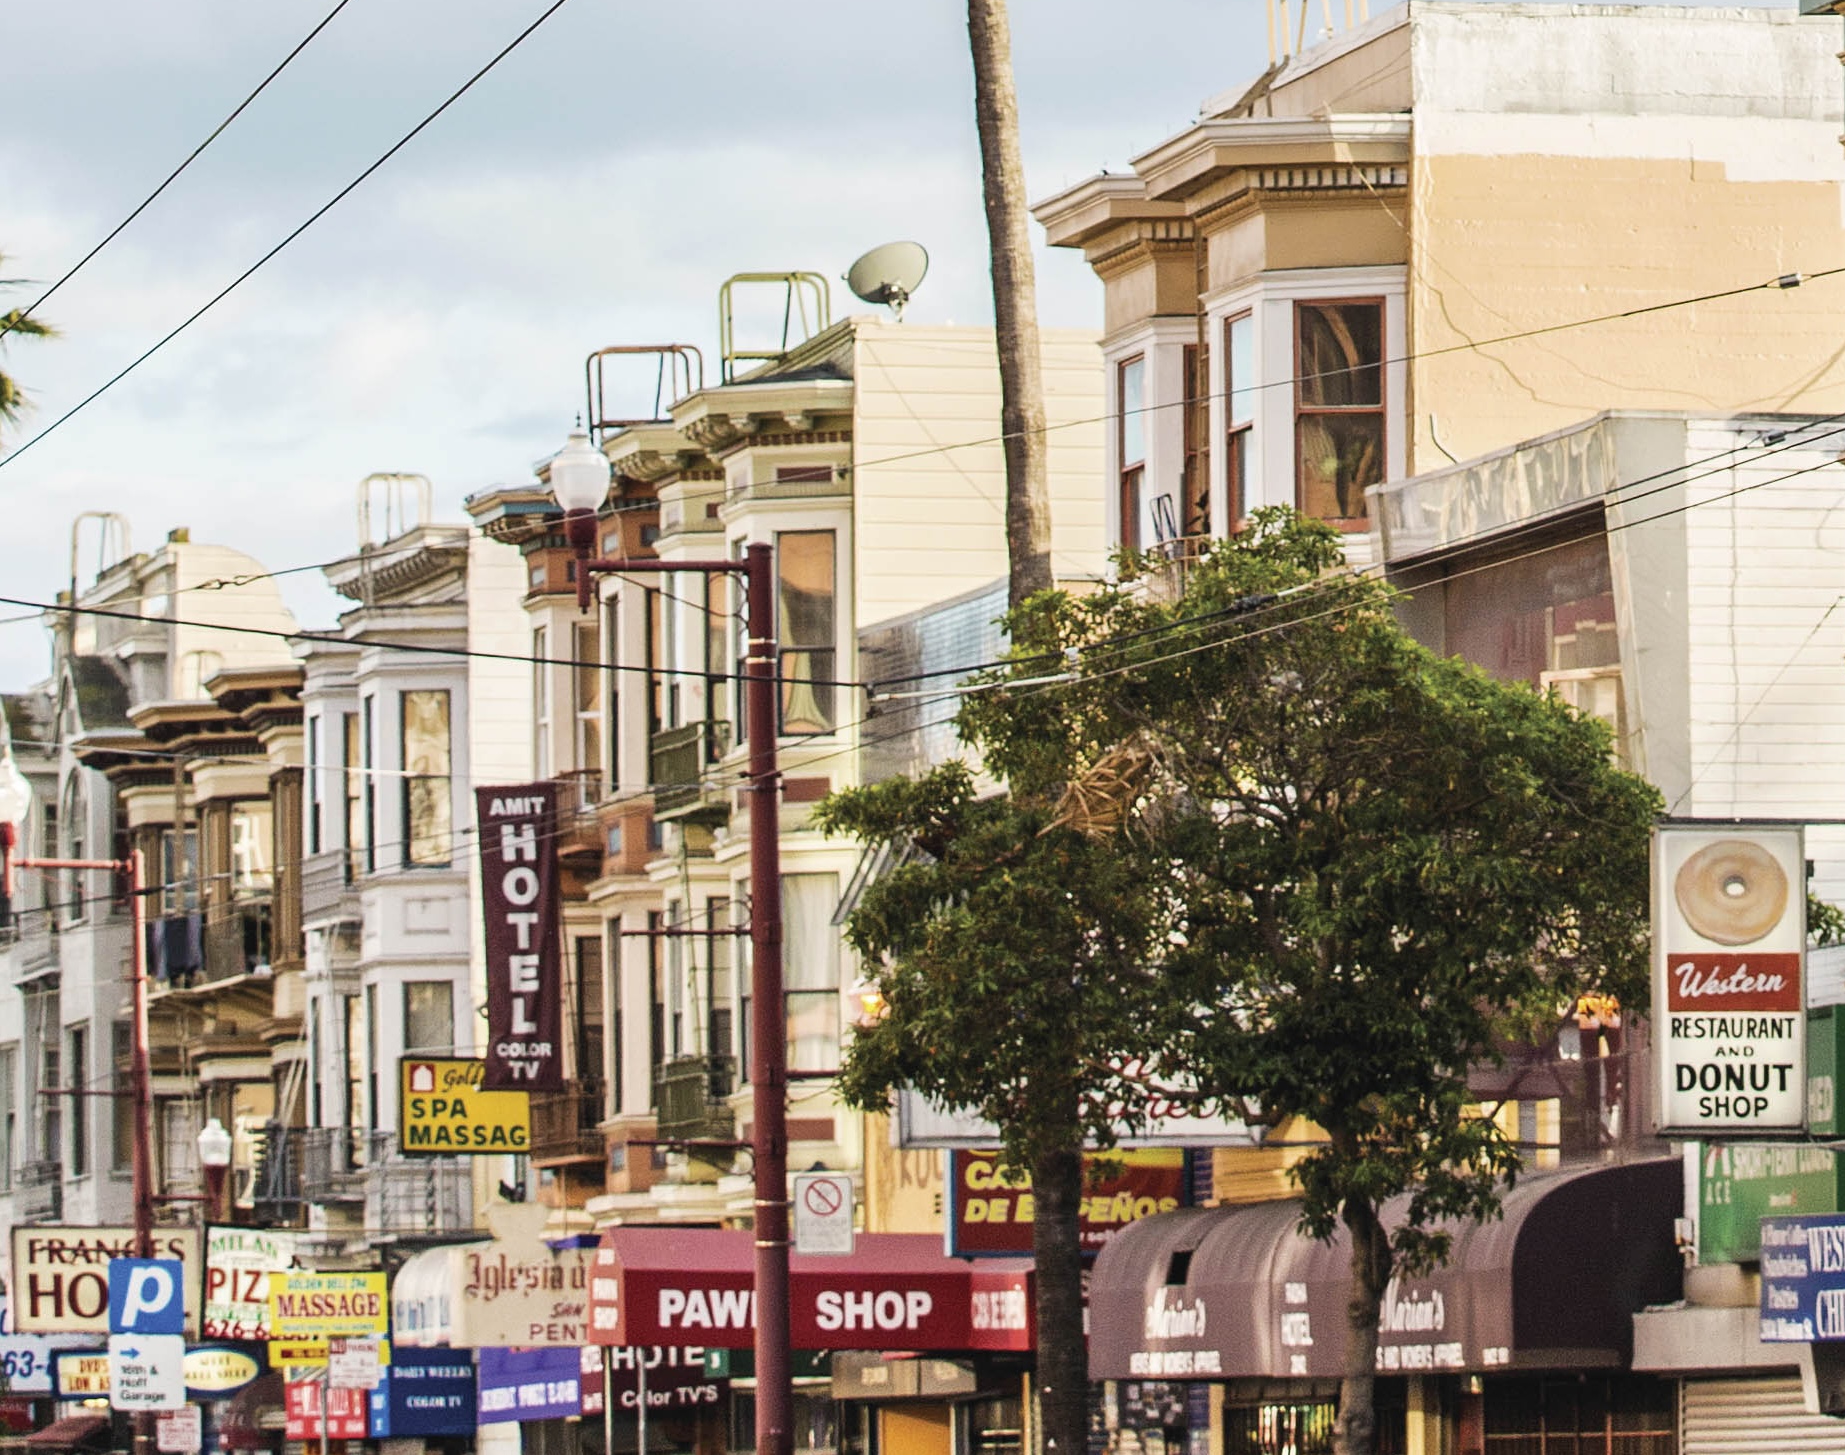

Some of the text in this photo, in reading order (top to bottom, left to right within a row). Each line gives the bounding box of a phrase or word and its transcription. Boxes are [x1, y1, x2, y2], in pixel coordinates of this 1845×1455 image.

[489, 796, 545, 816] AMIT
[500, 823, 540, 1035] HOTEL
[1674, 962, 1787, 998] Western
[1671, 1017, 1796, 1039] RESTAURANT
[496, 1042, 551, 1058] COLOR
[1714, 1046, 1755, 1057] AND
[507, 1060, 540, 1079] TV
[1676, 1063, 1793, 1092] DONUT
[410, 1098, 468, 1119] SPA
[1699, 1096, 1769, 1117] SHOP
[965, 1159, 1033, 1191] CAS
[964, 1198, 1010, 1224] DE
[465, 1253, 566, 1302] Iglesia
[278, 1292, 381, 1318] MASSAGE
[658, 1288, 758, 1328] PAW
[815, 1290, 933, 1331] SHOP
[611, 1345, 705, 1370] HOTE
